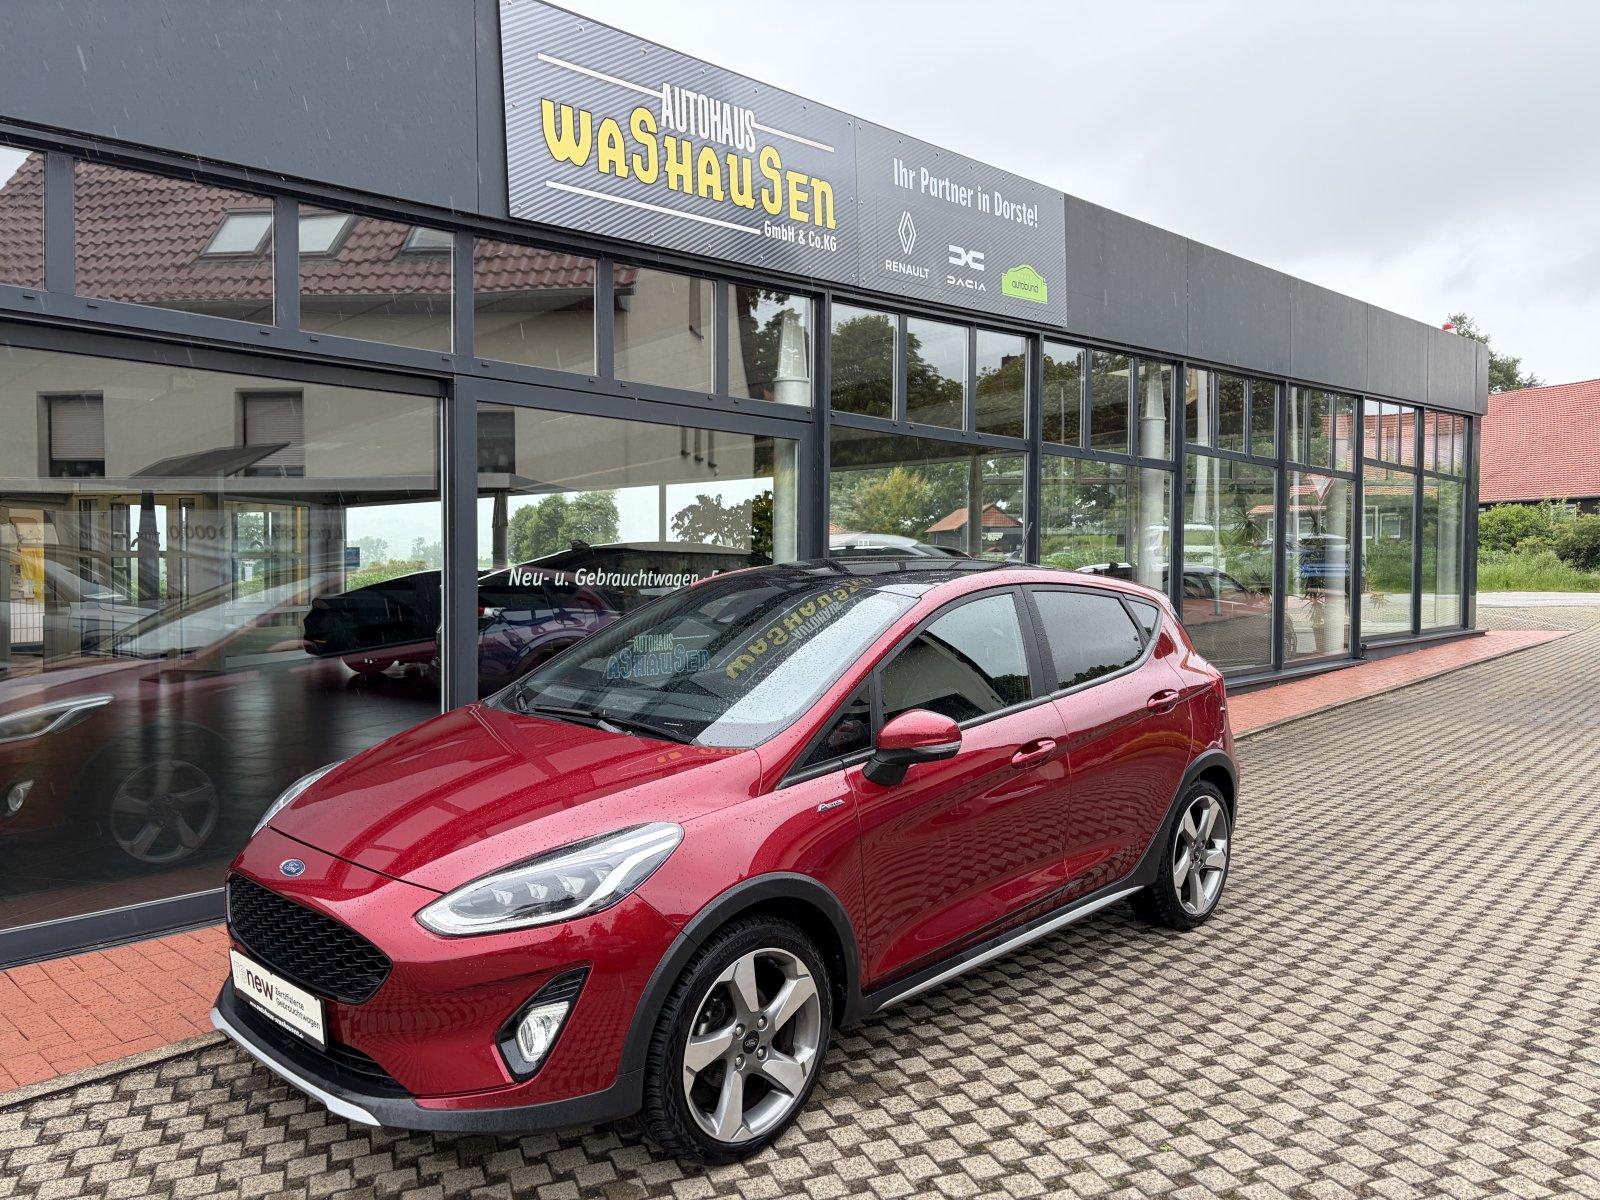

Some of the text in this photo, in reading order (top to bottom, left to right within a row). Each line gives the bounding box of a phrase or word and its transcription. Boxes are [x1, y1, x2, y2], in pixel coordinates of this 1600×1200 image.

[661, 83, 756, 153] AUTOHAUS
[893, 157, 1038, 228] Ihr Partner in Dorste!
[764, 220, 837, 252] GmbH & Co.KG
[885, 259, 930, 279] RENAULT
[946, 275, 987, 292] DACIA
[508, 567, 699, 591] Neu- u. Gebrauchtwagen
[633, 632, 674, 653] AUTOHAUS
[605, 643, 710, 680] ASHAUSEN
[275, 997, 321, 1030] Gebrauchtwagen
